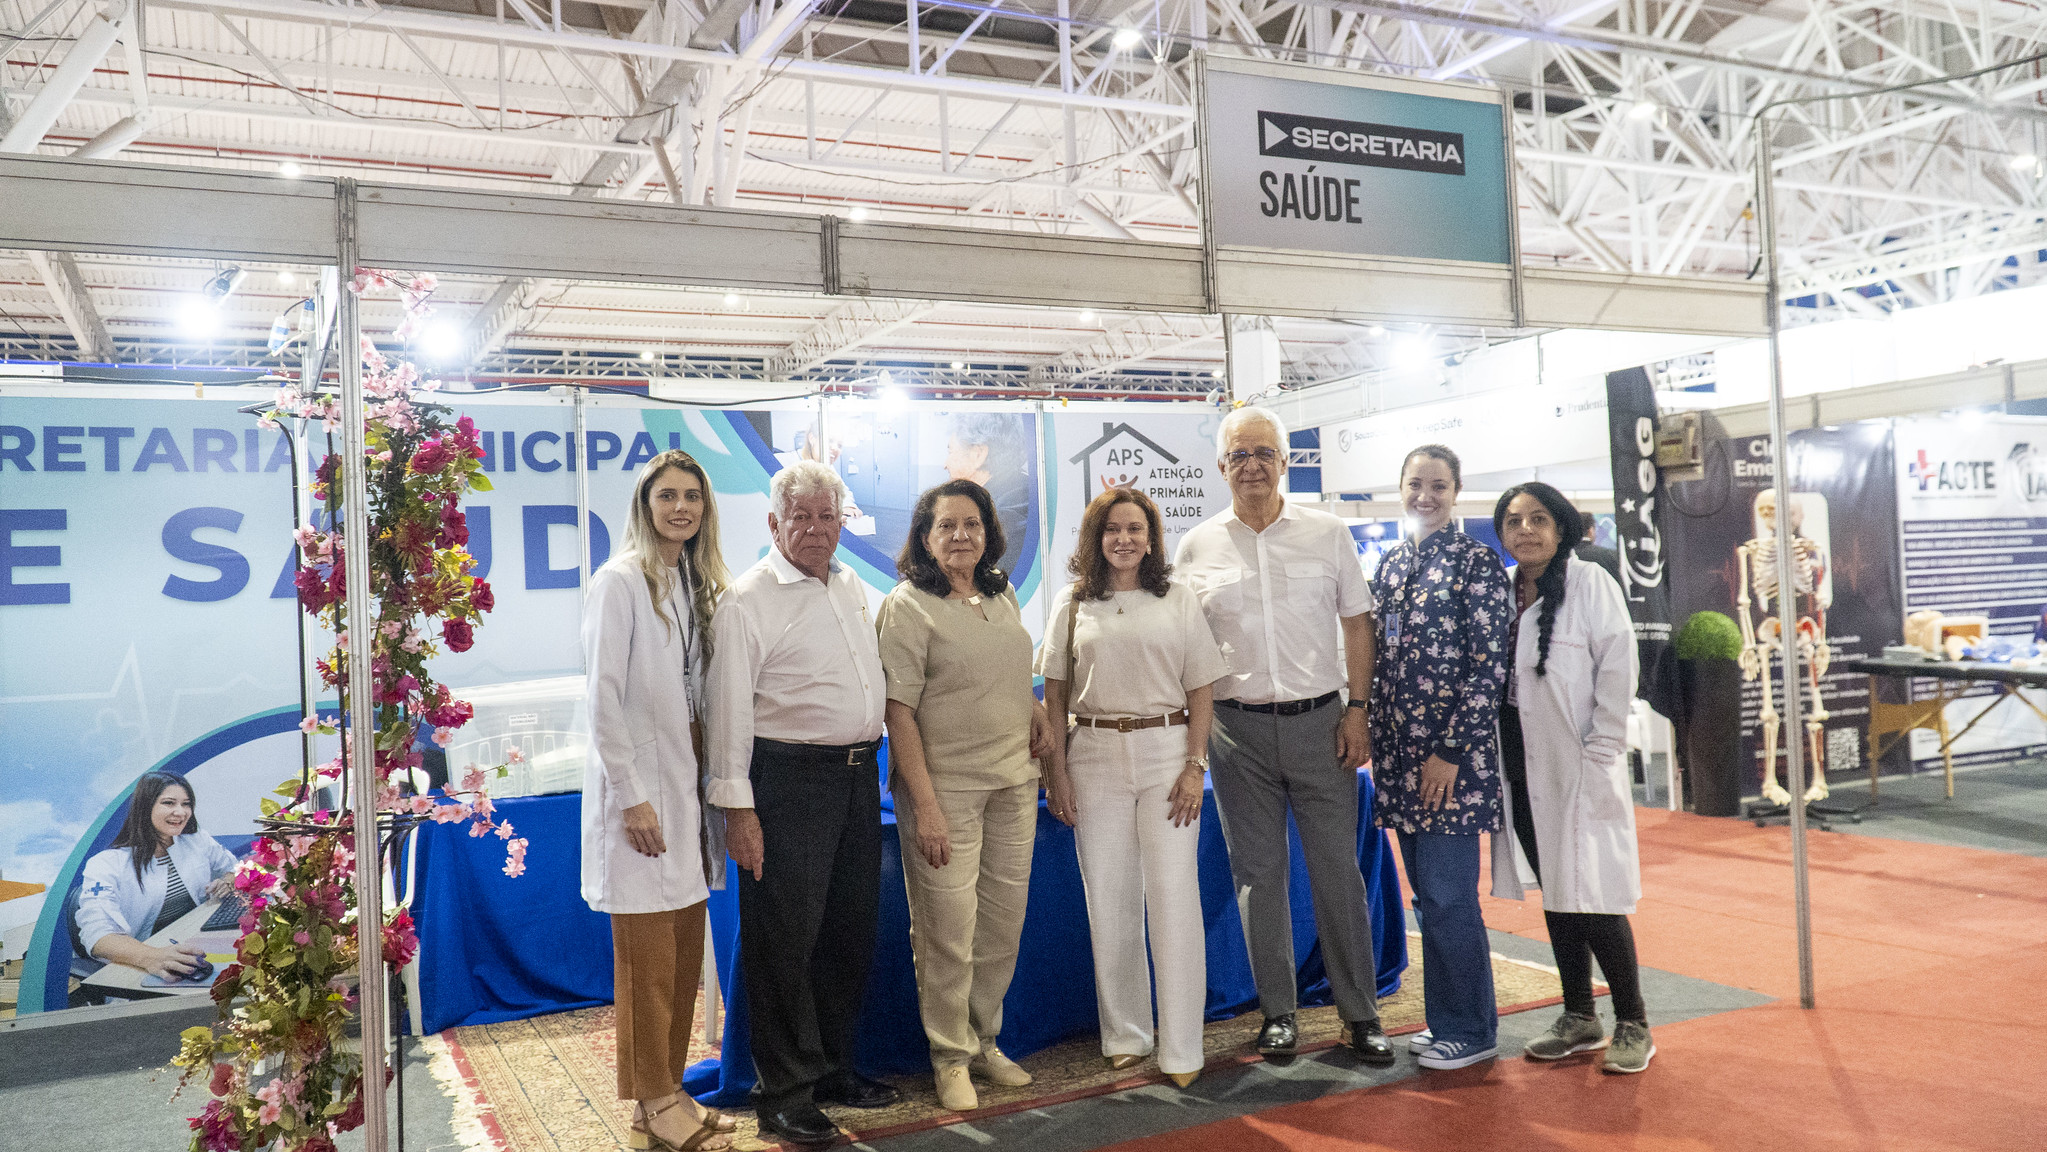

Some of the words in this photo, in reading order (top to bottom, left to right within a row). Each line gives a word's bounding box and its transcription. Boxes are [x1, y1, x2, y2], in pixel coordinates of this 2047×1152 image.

[1291, 126, 1463, 164] SECRETARIA
[1259, 165, 1363, 224] SAÚDE
[1106, 448, 1144, 466] APS
[1149, 466, 1204, 482] ATENÇÃO
[1149, 485, 1205, 498] PRIMÁRIA
[1165, 504, 1202, 518] SAÚDE
